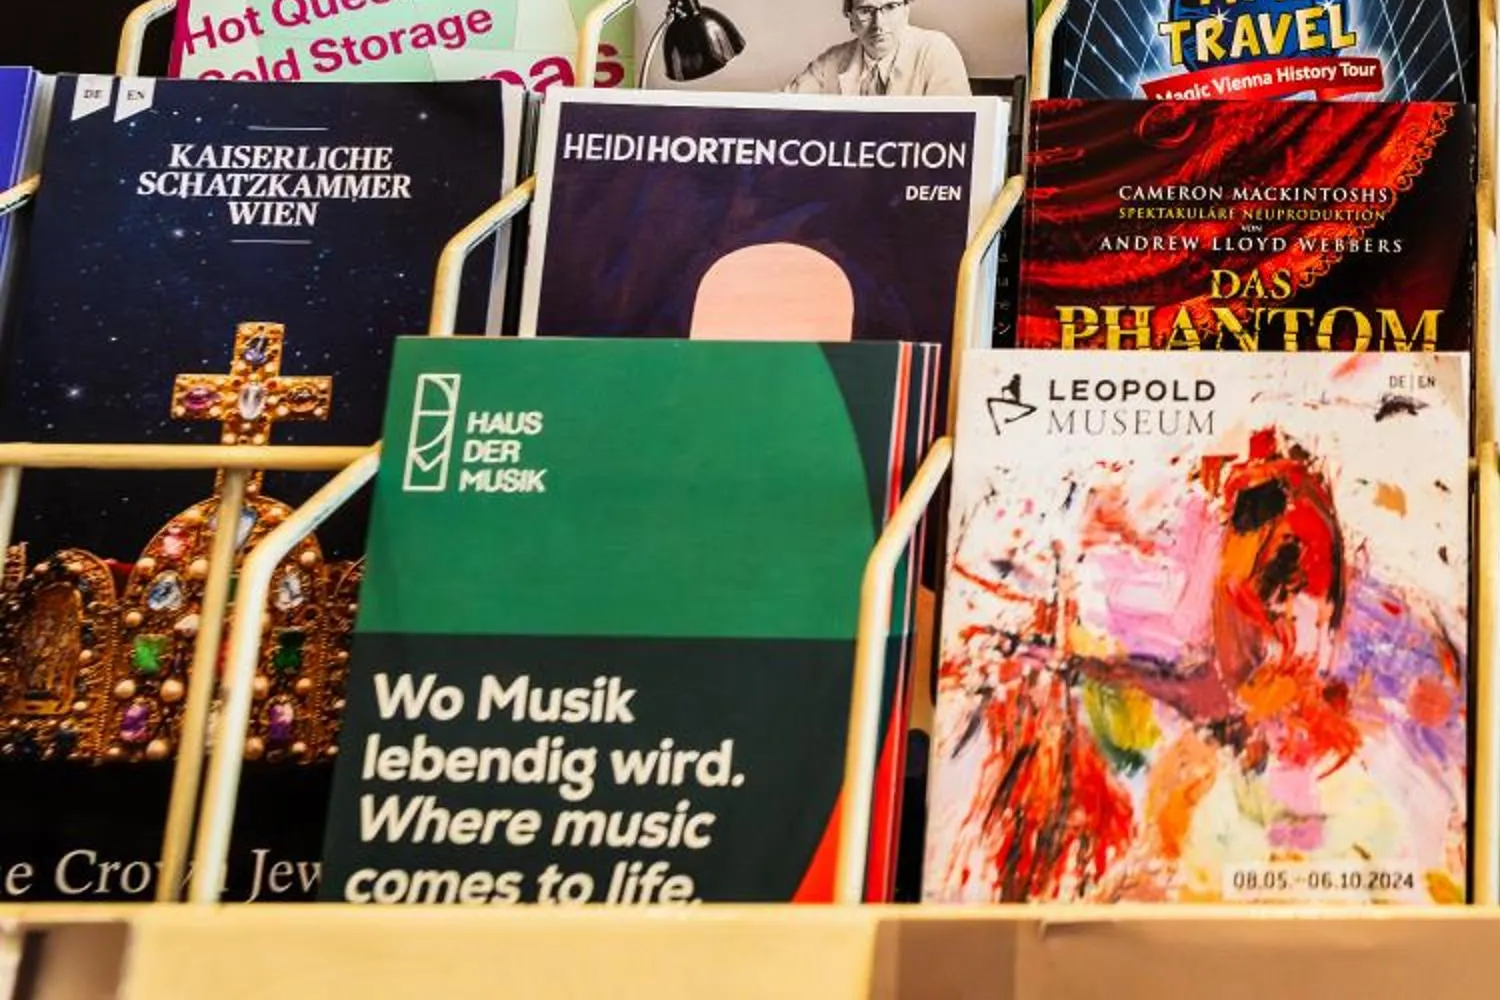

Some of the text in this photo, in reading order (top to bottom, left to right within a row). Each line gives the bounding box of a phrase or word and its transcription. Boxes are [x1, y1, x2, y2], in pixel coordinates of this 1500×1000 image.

[185, 5, 265, 56] Hot
[308, 8, 494, 74] Storage
[1157, 3, 1357, 66] TRAVEL
[1211, 62, 1377, 96] Vienna History Tour
[168, 142, 394, 172] KAISERLICHE
[136, 172, 412, 200] SCHATZKAMMER
[905, 184, 962, 202] DE/EN
[1118, 184, 1388, 203] CAMERON MACKINTOSHS
[227, 201, 320, 227] WIEN
[1242, 206, 1386, 222] NEUPRODUKTION
[1100, 236, 1403, 254] ANDREW LLOYD WEBBERS
[1210, 268, 1292, 300] DAS
[1055, 304, 1445, 354] PHANTOM
[1048, 379, 1216, 402] LEOPOLD
[466, 411, 543, 434] HAUS
[1046, 408, 1216, 436] MUSEUM
[463, 440, 521, 463] DER
[458, 469, 547, 493] MUSIK
[373, 672, 637, 725] Wo Musik
[361, 733, 746, 801] lebendig wird.
[358, 794, 718, 849] Where music
[343, 864, 523, 904] comes
[536, 863, 595, 904] to
